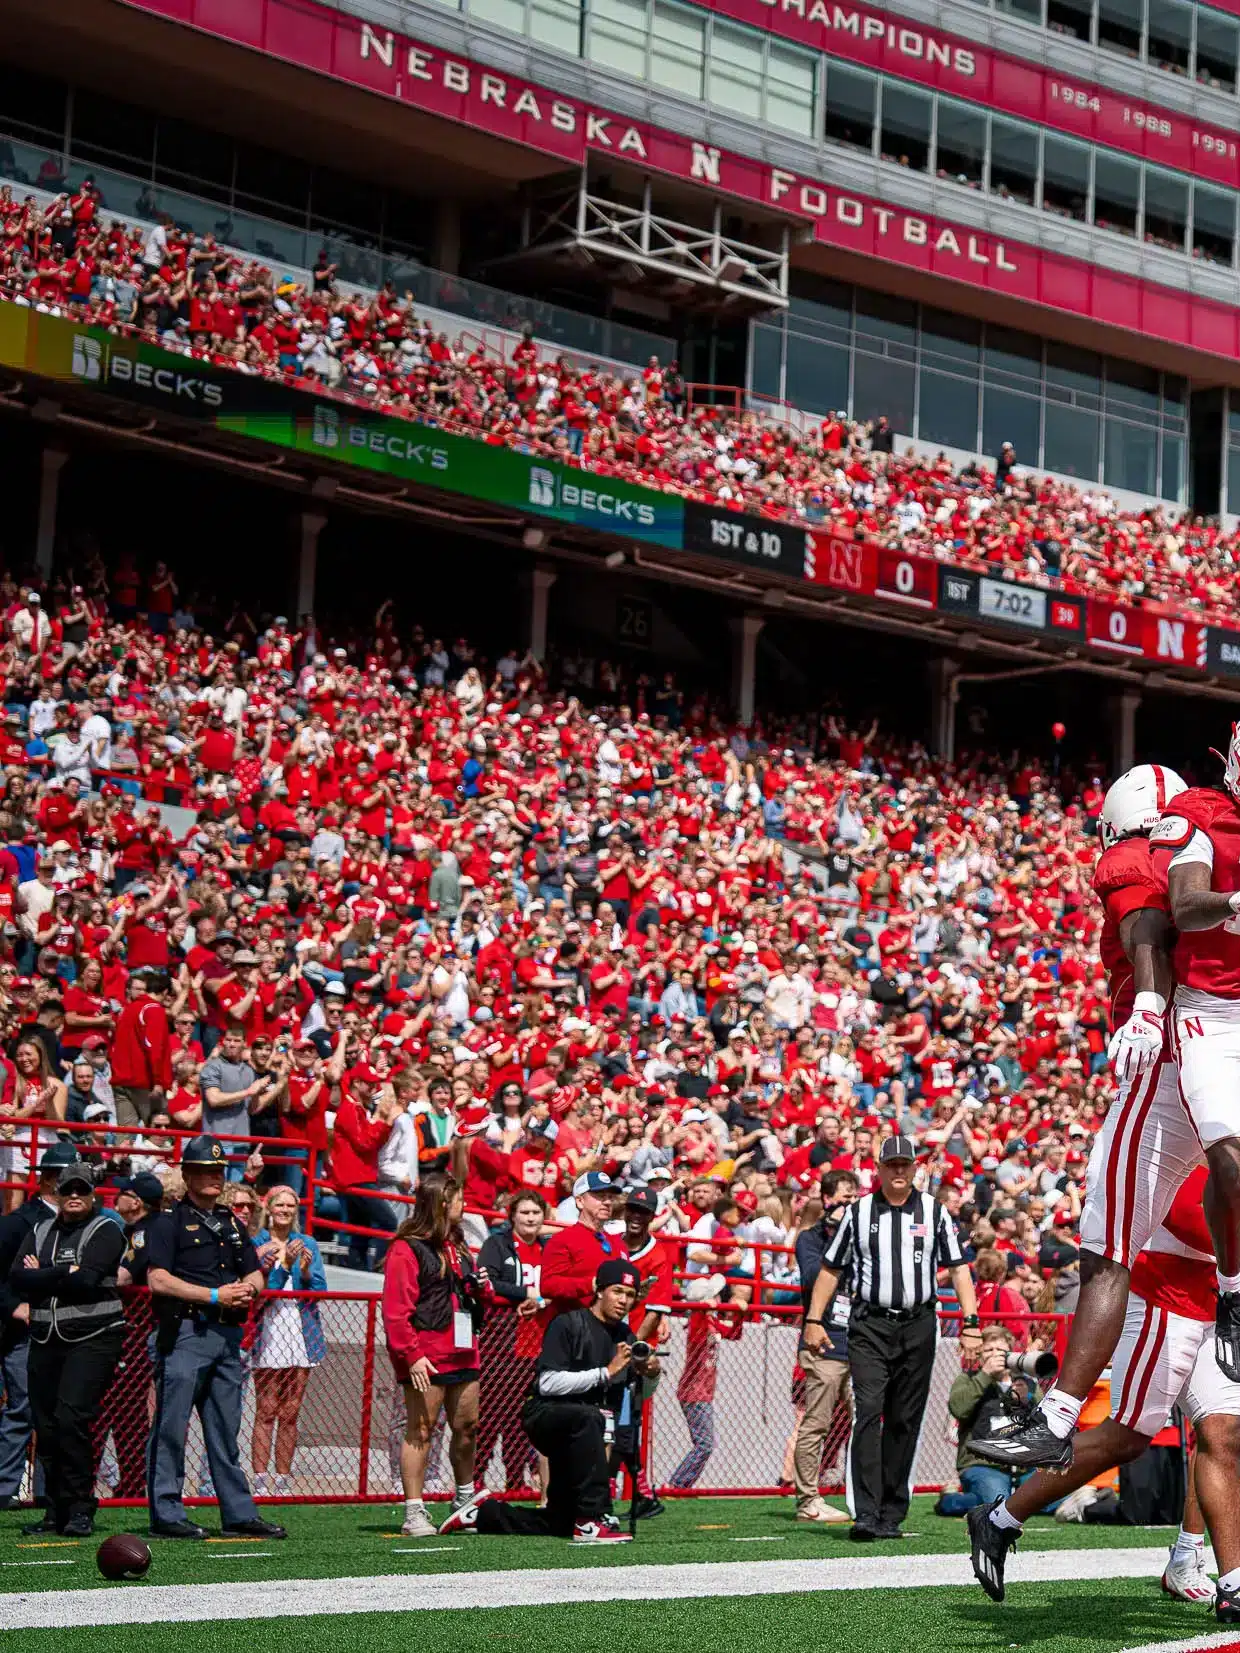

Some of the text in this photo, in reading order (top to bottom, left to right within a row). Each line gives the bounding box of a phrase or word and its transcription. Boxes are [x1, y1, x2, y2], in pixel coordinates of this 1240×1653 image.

[1051, 82, 1102, 112] 1984
[1123, 108, 1172, 137] 1988
[1192, 131, 1236, 160] 1991
[360, 24, 1017, 272] NEBRASKA N FOOTBALL
[111, 356, 223, 407] BECK'S
[348, 427, 449, 470] BECK'S
[562, 487, 656, 525] BECK'S
[711, 519, 781, 558] 1ST & 10
[829, 539, 863, 589] N
[896, 561, 914, 592] 0
[948, 581, 971, 601] 1ST
[993, 588, 1033, 616] 7:02
[1109, 611, 1127, 641] 0
[1157, 618, 1185, 659] N
[1184, 1016, 1204, 1039] N
[870, 1223, 879, 1233] S
[914, 1250, 923, 1263] S
